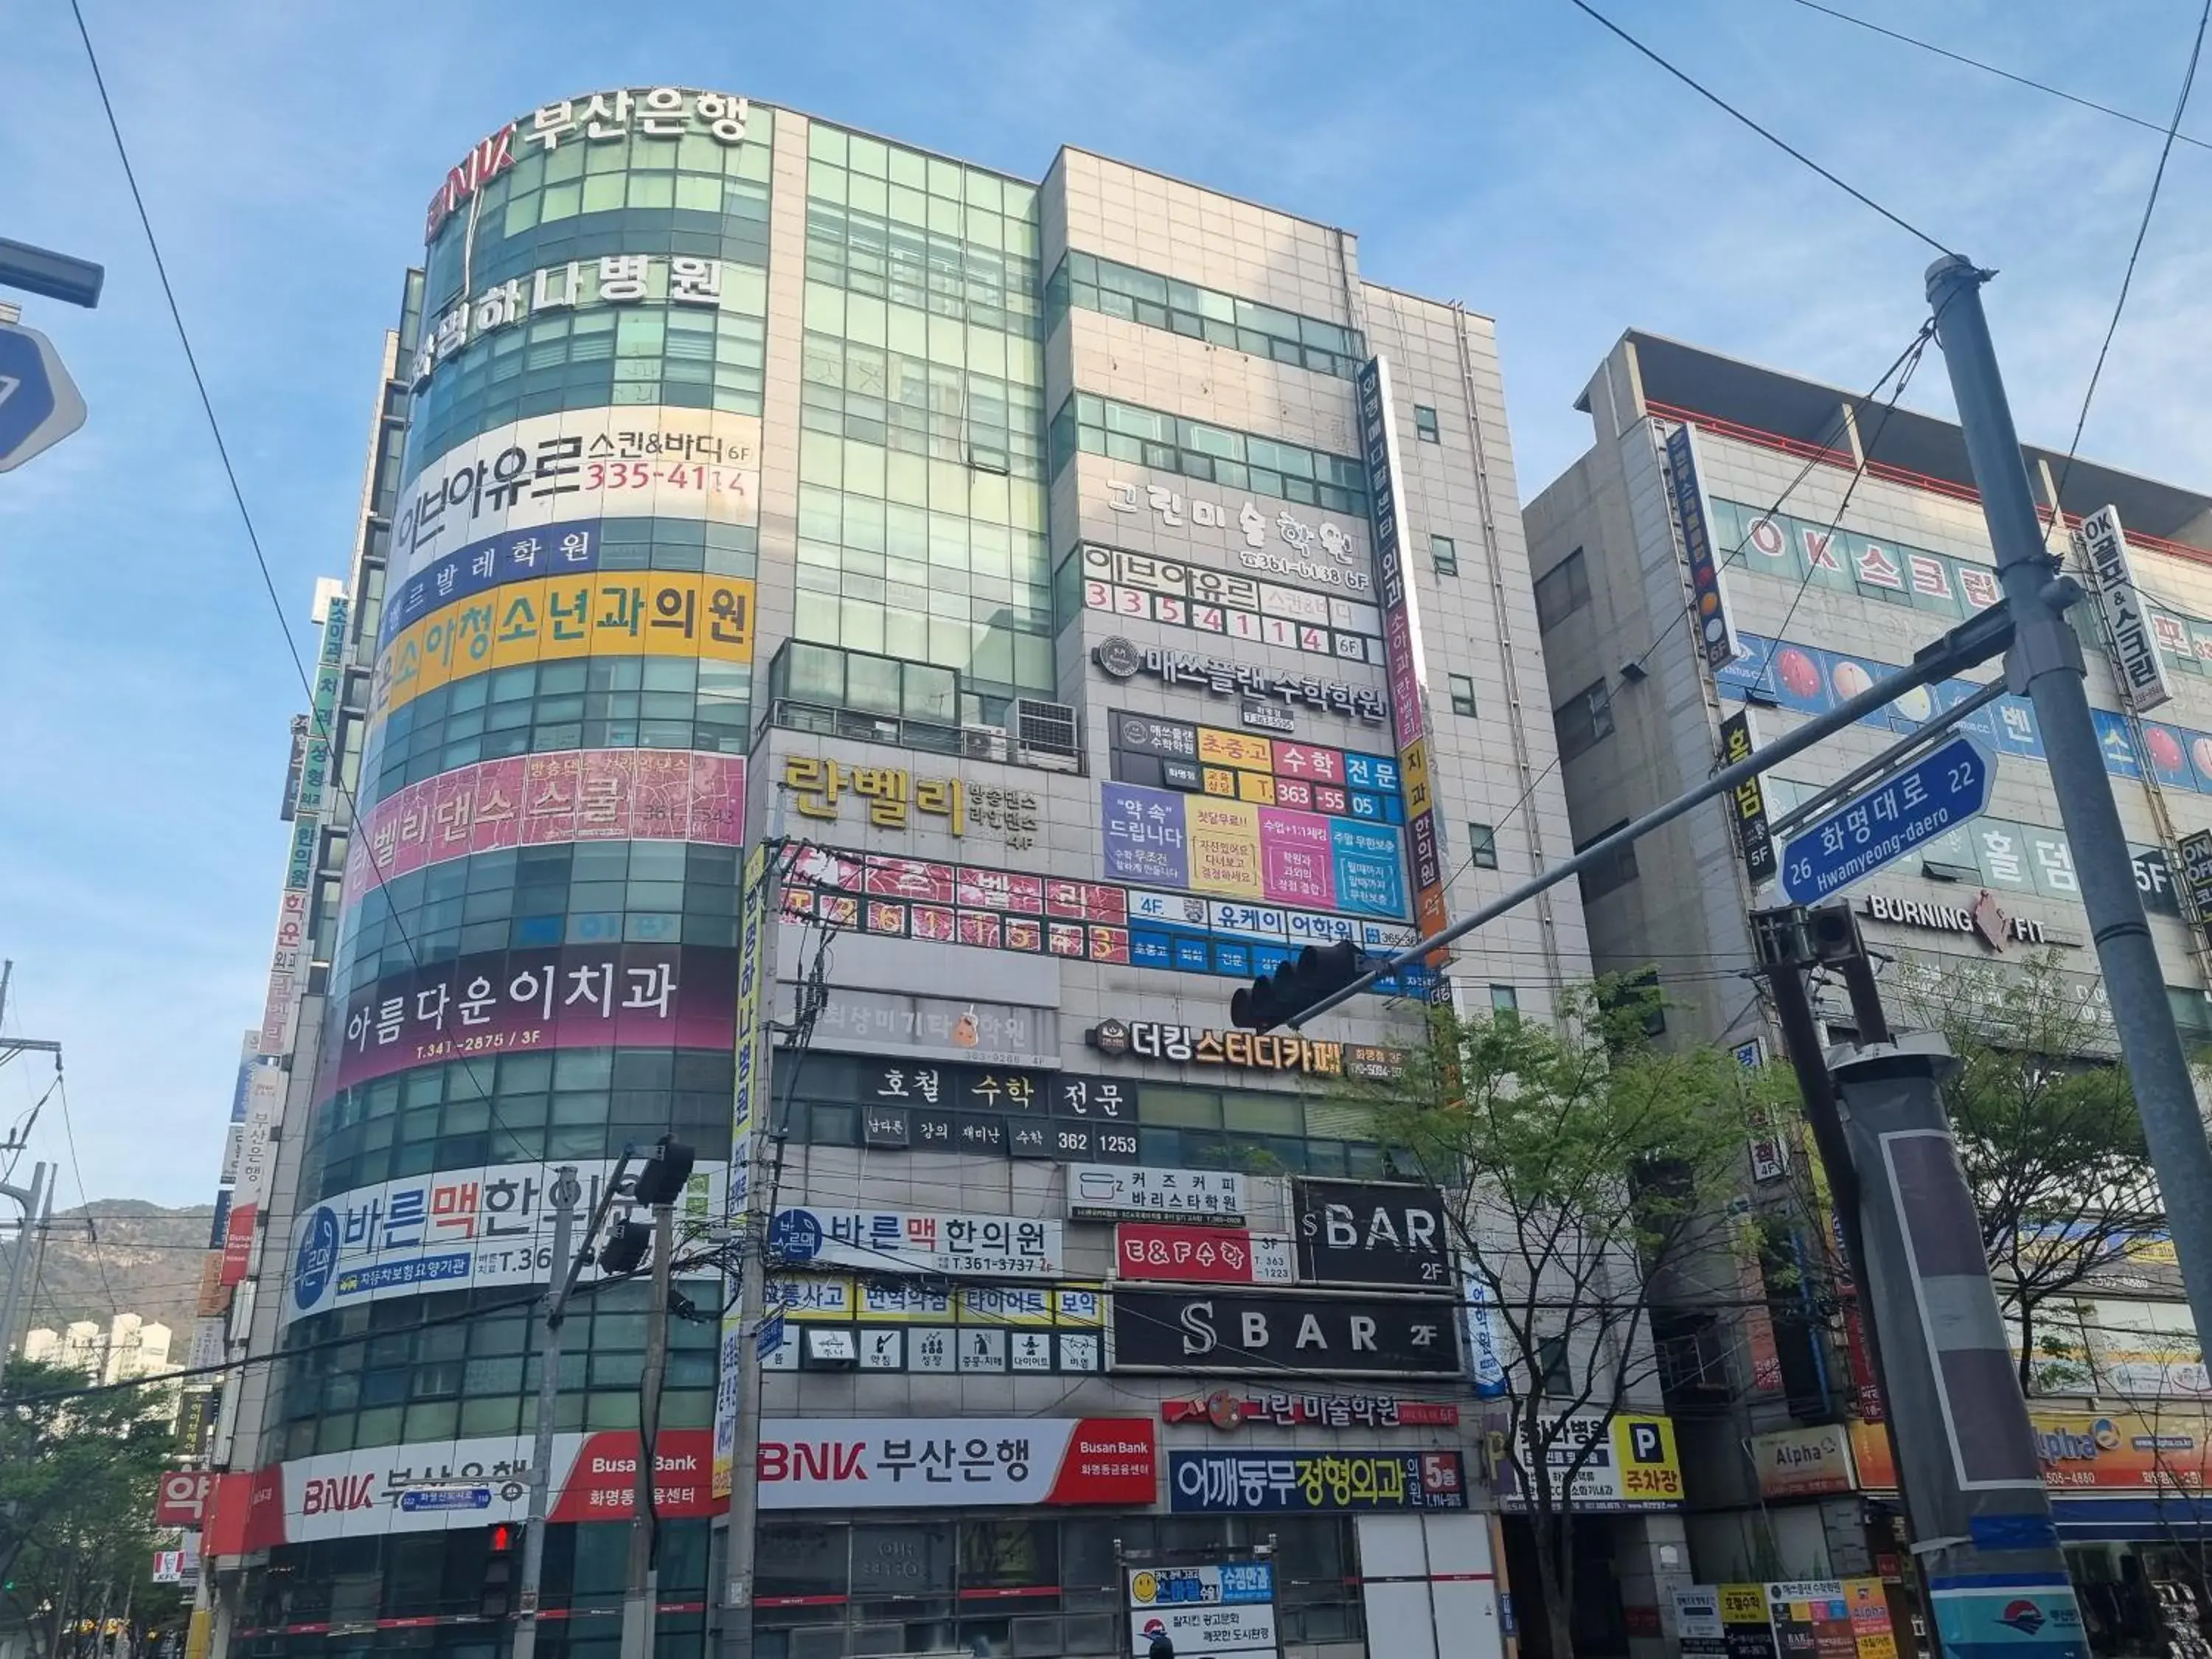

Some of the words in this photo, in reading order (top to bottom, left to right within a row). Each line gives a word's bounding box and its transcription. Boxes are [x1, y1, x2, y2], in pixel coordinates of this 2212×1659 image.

[525, 88, 748, 149] 부산은행
[398, 436, 583, 555] 이브아유르
[588, 431, 723, 463] 스킨&바디
[728, 445, 751, 462] 6F
[2084, 512, 2112, 540] OK
[1085, 549, 1255, 608] 이브아유르
[1345, 571, 1369, 590] 6F
[1382, 551, 1403, 609] 외과
[1088, 581, 1322, 650] 335-4114
[1340, 638, 1358, 655] 6F
[1391, 613, 1411, 675] 소아과
[1709, 641, 1728, 662] 6F
[1147, 649, 1267, 702] 매쓰플랜
[1273, 673, 1387, 721] 수학학원
[1150, 725, 1194, 740] 매쓰플랜
[1150, 737, 1194, 754] 수학학원
[1169, 768, 1195, 780] 화명점
[1208, 770, 1228, 781] 교육
[1283, 747, 1333, 779] 수학
[1349, 754, 1397, 787] 전문
[1407, 751, 1427, 806] 치과
[787, 756, 964, 836] 란벨리
[970, 785, 1036, 810] 방송댄스
[1207, 781, 1230, 793] 상담
[1820, 773, 1929, 857] 화명대로
[1947, 761, 1975, 794] 22
[1109, 820, 1183, 848] 드립니다
[1135, 849, 1168, 866] 무조건
[1206, 855, 1244, 868] 다녀보고
[1414, 815, 1436, 886] 한의원
[1750, 846, 1769, 867] 5F
[1790, 857, 1813, 886] 26
[1817, 807, 1948, 893] Hwamyeong-daero
[1981, 830, 2078, 892] 홀덤
[1202, 867, 1251, 883] 결정하세요
[1217, 906, 1281, 934] 유케이
[1293, 917, 1354, 944] 어학원
[1869, 894, 1973, 933] BURNING
[2015, 918, 2046, 944] FIT
[417, 1036, 504, 1060] T.341-2875
[521, 1031, 540, 1045] 3F
[980, 1013, 1026, 1048] 학원
[877, 1068, 940, 1102] 호철
[970, 1075, 1035, 1109] 수학
[1064, 1082, 1124, 1118] 전문
[246, 1112, 268, 1182] 부산은행
[868, 1117, 904, 1135] 남다른
[919, 1121, 948, 1140] 강의
[961, 1125, 1001, 1144] 재미난
[1015, 1130, 1044, 1146] 수학
[1058, 1133, 1087, 1150] 362
[1099, 1135, 1137, 1154] 1253
[1132, 1172, 1236, 1194] 커즈커피
[1132, 1193, 1237, 1212] 바리스타학원
[832, 1215, 1046, 1256] 바른맥한의원
[1303, 1213, 1318, 1237] S
[1326, 1204, 1437, 1253] BAR
[1262, 1237, 1279, 1251] 3F
[361, 1259, 466, 1285] 자동차보험요양기관
[953, 1257, 1034, 1273] T.361-3737
[1421, 1262, 1443, 1281] 2F
[967, 1291, 1044, 1312] 다이어트
[1062, 1292, 1098, 1315] 보약
[1180, 1301, 1217, 1355] S
[1411, 1325, 1437, 1346] 2F
[1014, 1357, 1050, 1367] 다이어트
[1246, 1394, 1295, 1426] 그린
[1304, 1394, 1401, 1427] 미술학원
[1080, 1441, 1117, 1454] Busan
[1119, 1442, 1148, 1454] Bank
[1637, 1428, 1656, 1458] P
[1776, 1444, 1821, 1467] Alpha
[757, 1442, 867, 1481] BNK
[877, 1439, 1029, 1483] 부산은행
[1081, 1464, 1149, 1476] 화명동금융센터
[303, 1473, 375, 1514] BNK
[1178, 1456, 1407, 1506] 어깨동무정형외과
[1407, 1458, 1423, 1505] 의원
[1425, 1456, 1457, 1488] 5층
[1627, 1468, 1677, 1493] 주차장
